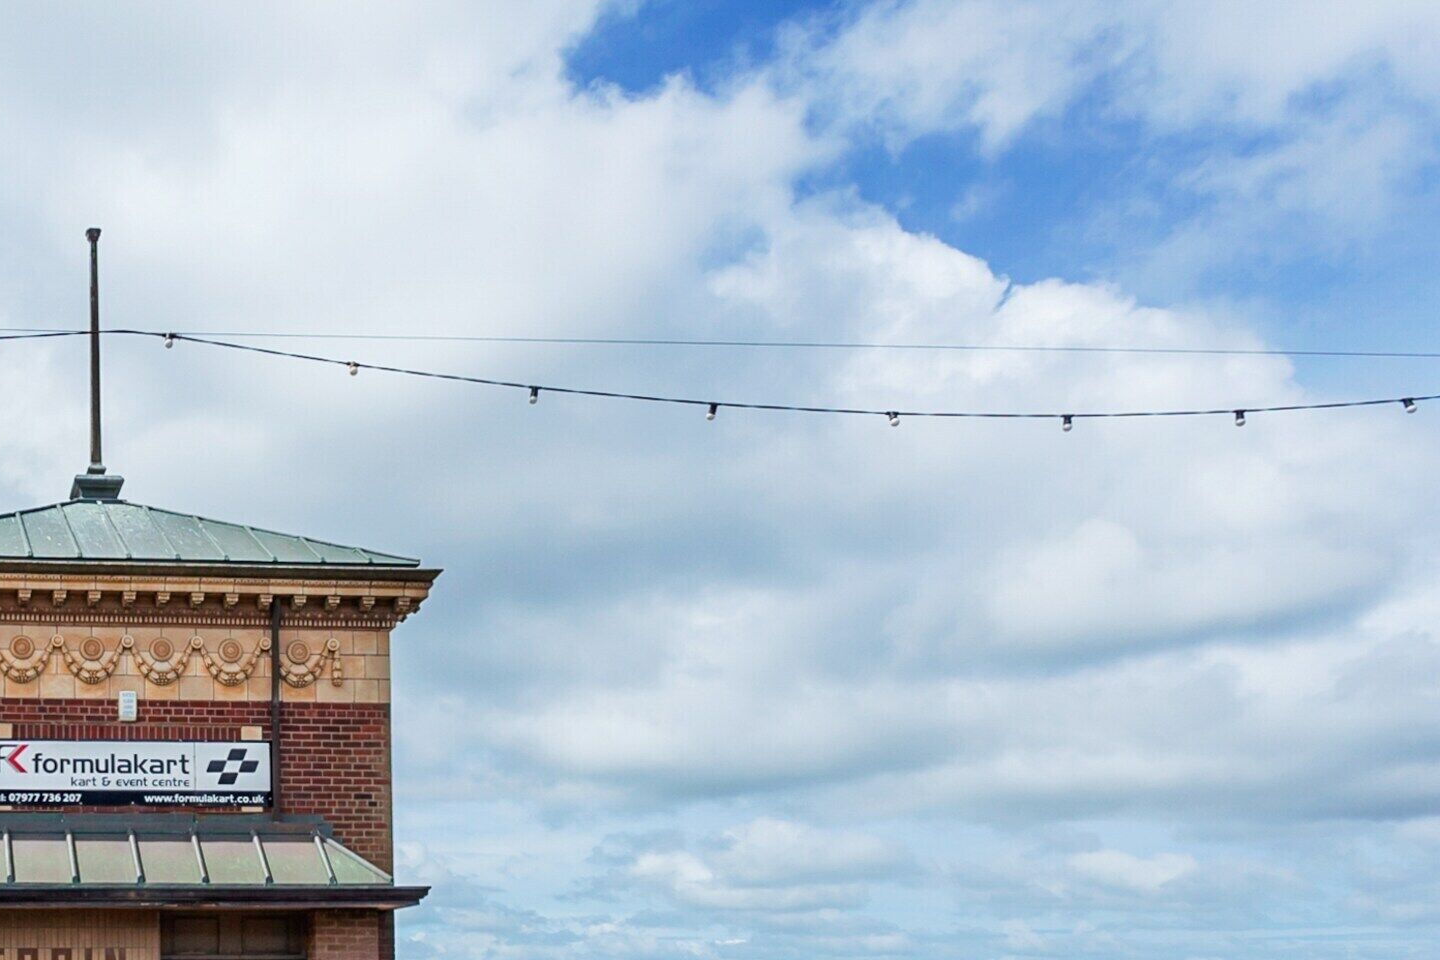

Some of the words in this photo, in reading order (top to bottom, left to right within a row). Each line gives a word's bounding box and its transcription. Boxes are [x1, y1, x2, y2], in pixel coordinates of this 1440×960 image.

[32, 753, 190, 775] formulakart
[70, 776, 97, 788] kart
[101, 777, 111, 788] &
[115, 777, 148, 788] event
[151, 777, 190, 788] centre
[8, 792, 40, 803] 07977
[41, 792, 62, 803] 736
[62, 792, 83, 803] 207
[144, 793, 265, 804] www.formulakart.co.uk
